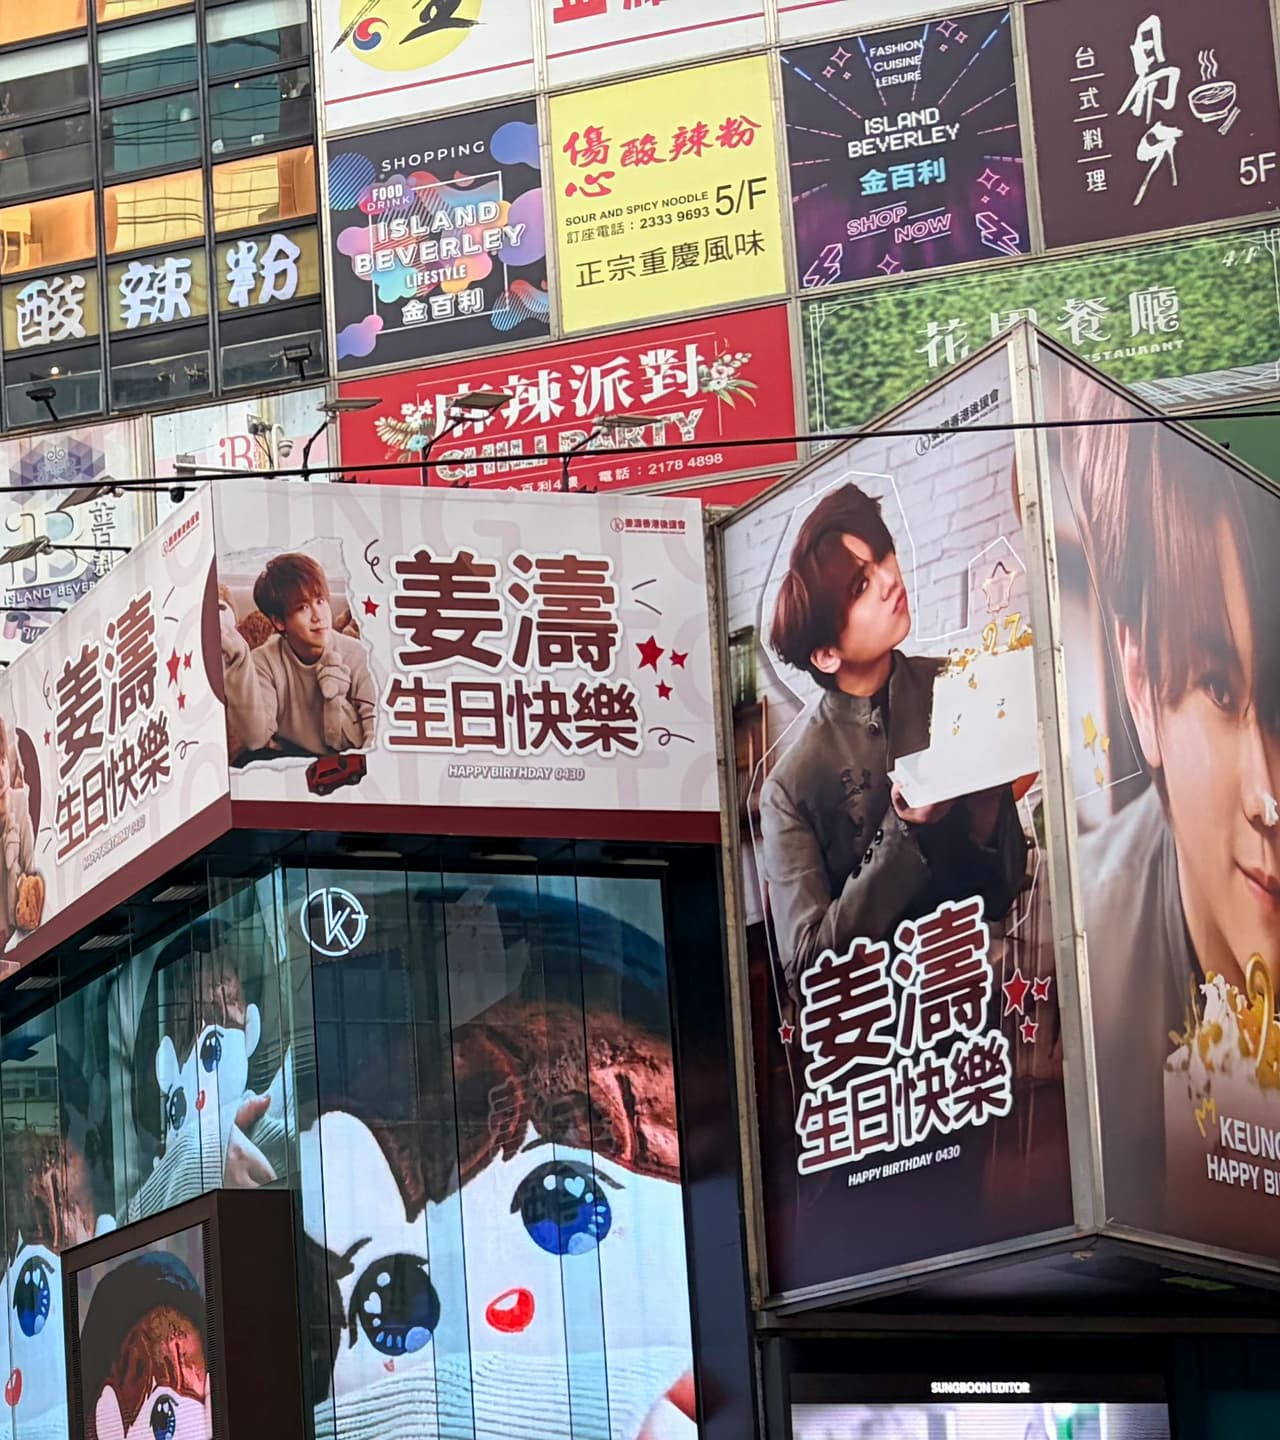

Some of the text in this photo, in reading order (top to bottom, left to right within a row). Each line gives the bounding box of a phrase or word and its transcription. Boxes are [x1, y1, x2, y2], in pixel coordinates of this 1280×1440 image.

[869, 39, 924, 58] FASHION
[873, 55, 922, 72] CUISINE
[875, 70, 922, 88] LEISURE
[864, 107, 940, 136] ISLAND
[1074, 46, 1109, 193] 台式料理
[381, 140, 486, 172] SHOPPING
[848, 122, 961, 160] BEVERLEY
[859, 157, 946, 196] 金百利
[1239, 152, 1278, 187] 5F
[367, 195, 411, 212] DRINK
[372, 183, 403, 201] FOOD
[565, 191, 709, 226] SOUR AND SPICY NOODLE
[715, 176, 768, 216] 5/F
[376, 200, 500, 242] ISLAND
[639, 213, 673, 229] 2333
[676, 206, 711, 222] 9693
[846, 205, 952, 244] SHOP NOW
[354, 223, 526, 275] BEVERLEY
[575, 229, 766, 288] 正宗重慶風味
[1222, 245, 1261, 267] 4/F
[405, 264, 467, 289] LIFESTYLE
[401, 287, 485, 325] 金百利
[434, 343, 707, 440] 麻辣派對
[436, 408, 704, 482] CHILI PARTY
[647, 452, 724, 476] 2178 4898
[4, 588, 51, 606] ISLAND
[393, 548, 621, 674] 姜濤
[55, 586, 159, 780] 姜濤
[384, 676, 640, 753] 生日快樂
[54, 710, 172, 862] 生日快樂
[448, 763, 586, 782] HAPPY BIRTHDAY 0430
[804, 898, 990, 1082] 姜濤
[799, 1035, 1008, 1171] 生日快樂
[848, 1144, 961, 1187] HAPPY BIRTHDAY 0430
[1206, 1153, 1261, 1190] HAPPY
[930, 1381, 1031, 1395] SUNGBOON EDITOR
